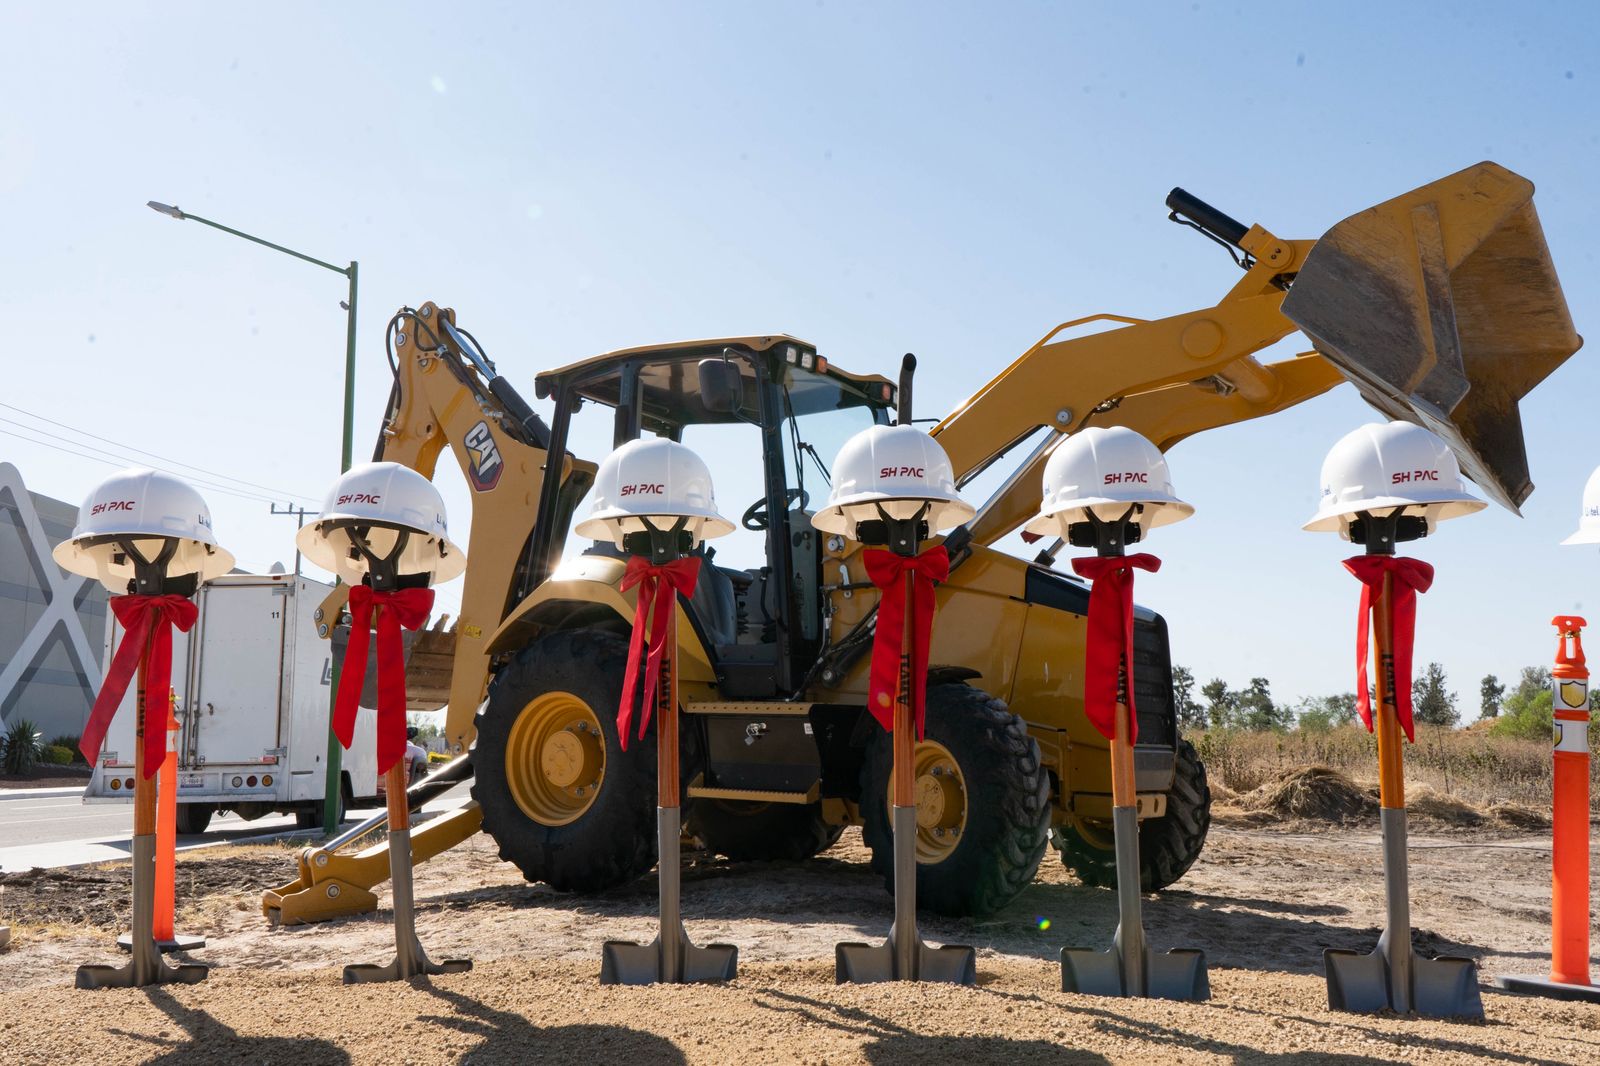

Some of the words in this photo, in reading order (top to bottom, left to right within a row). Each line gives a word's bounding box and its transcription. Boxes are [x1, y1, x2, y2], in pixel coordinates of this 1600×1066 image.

[464, 421, 502, 477] CAT
[879, 467, 898, 479] SH
[900, 466, 925, 478] PAC
[1104, 473, 1121, 485] SH
[1124, 472, 1148, 483] PAC
[1392, 471, 1411, 484] SH
[1414, 470, 1439, 481] PAC
[621, 485, 637, 497] SH
[639, 484, 665, 494] PAC
[337, 494, 353, 505] SH
[354, 494, 381, 504] PAC
[91, 503, 107, 516] SH
[107, 501, 136, 512] PAC
[271, 611, 280, 619] 11
